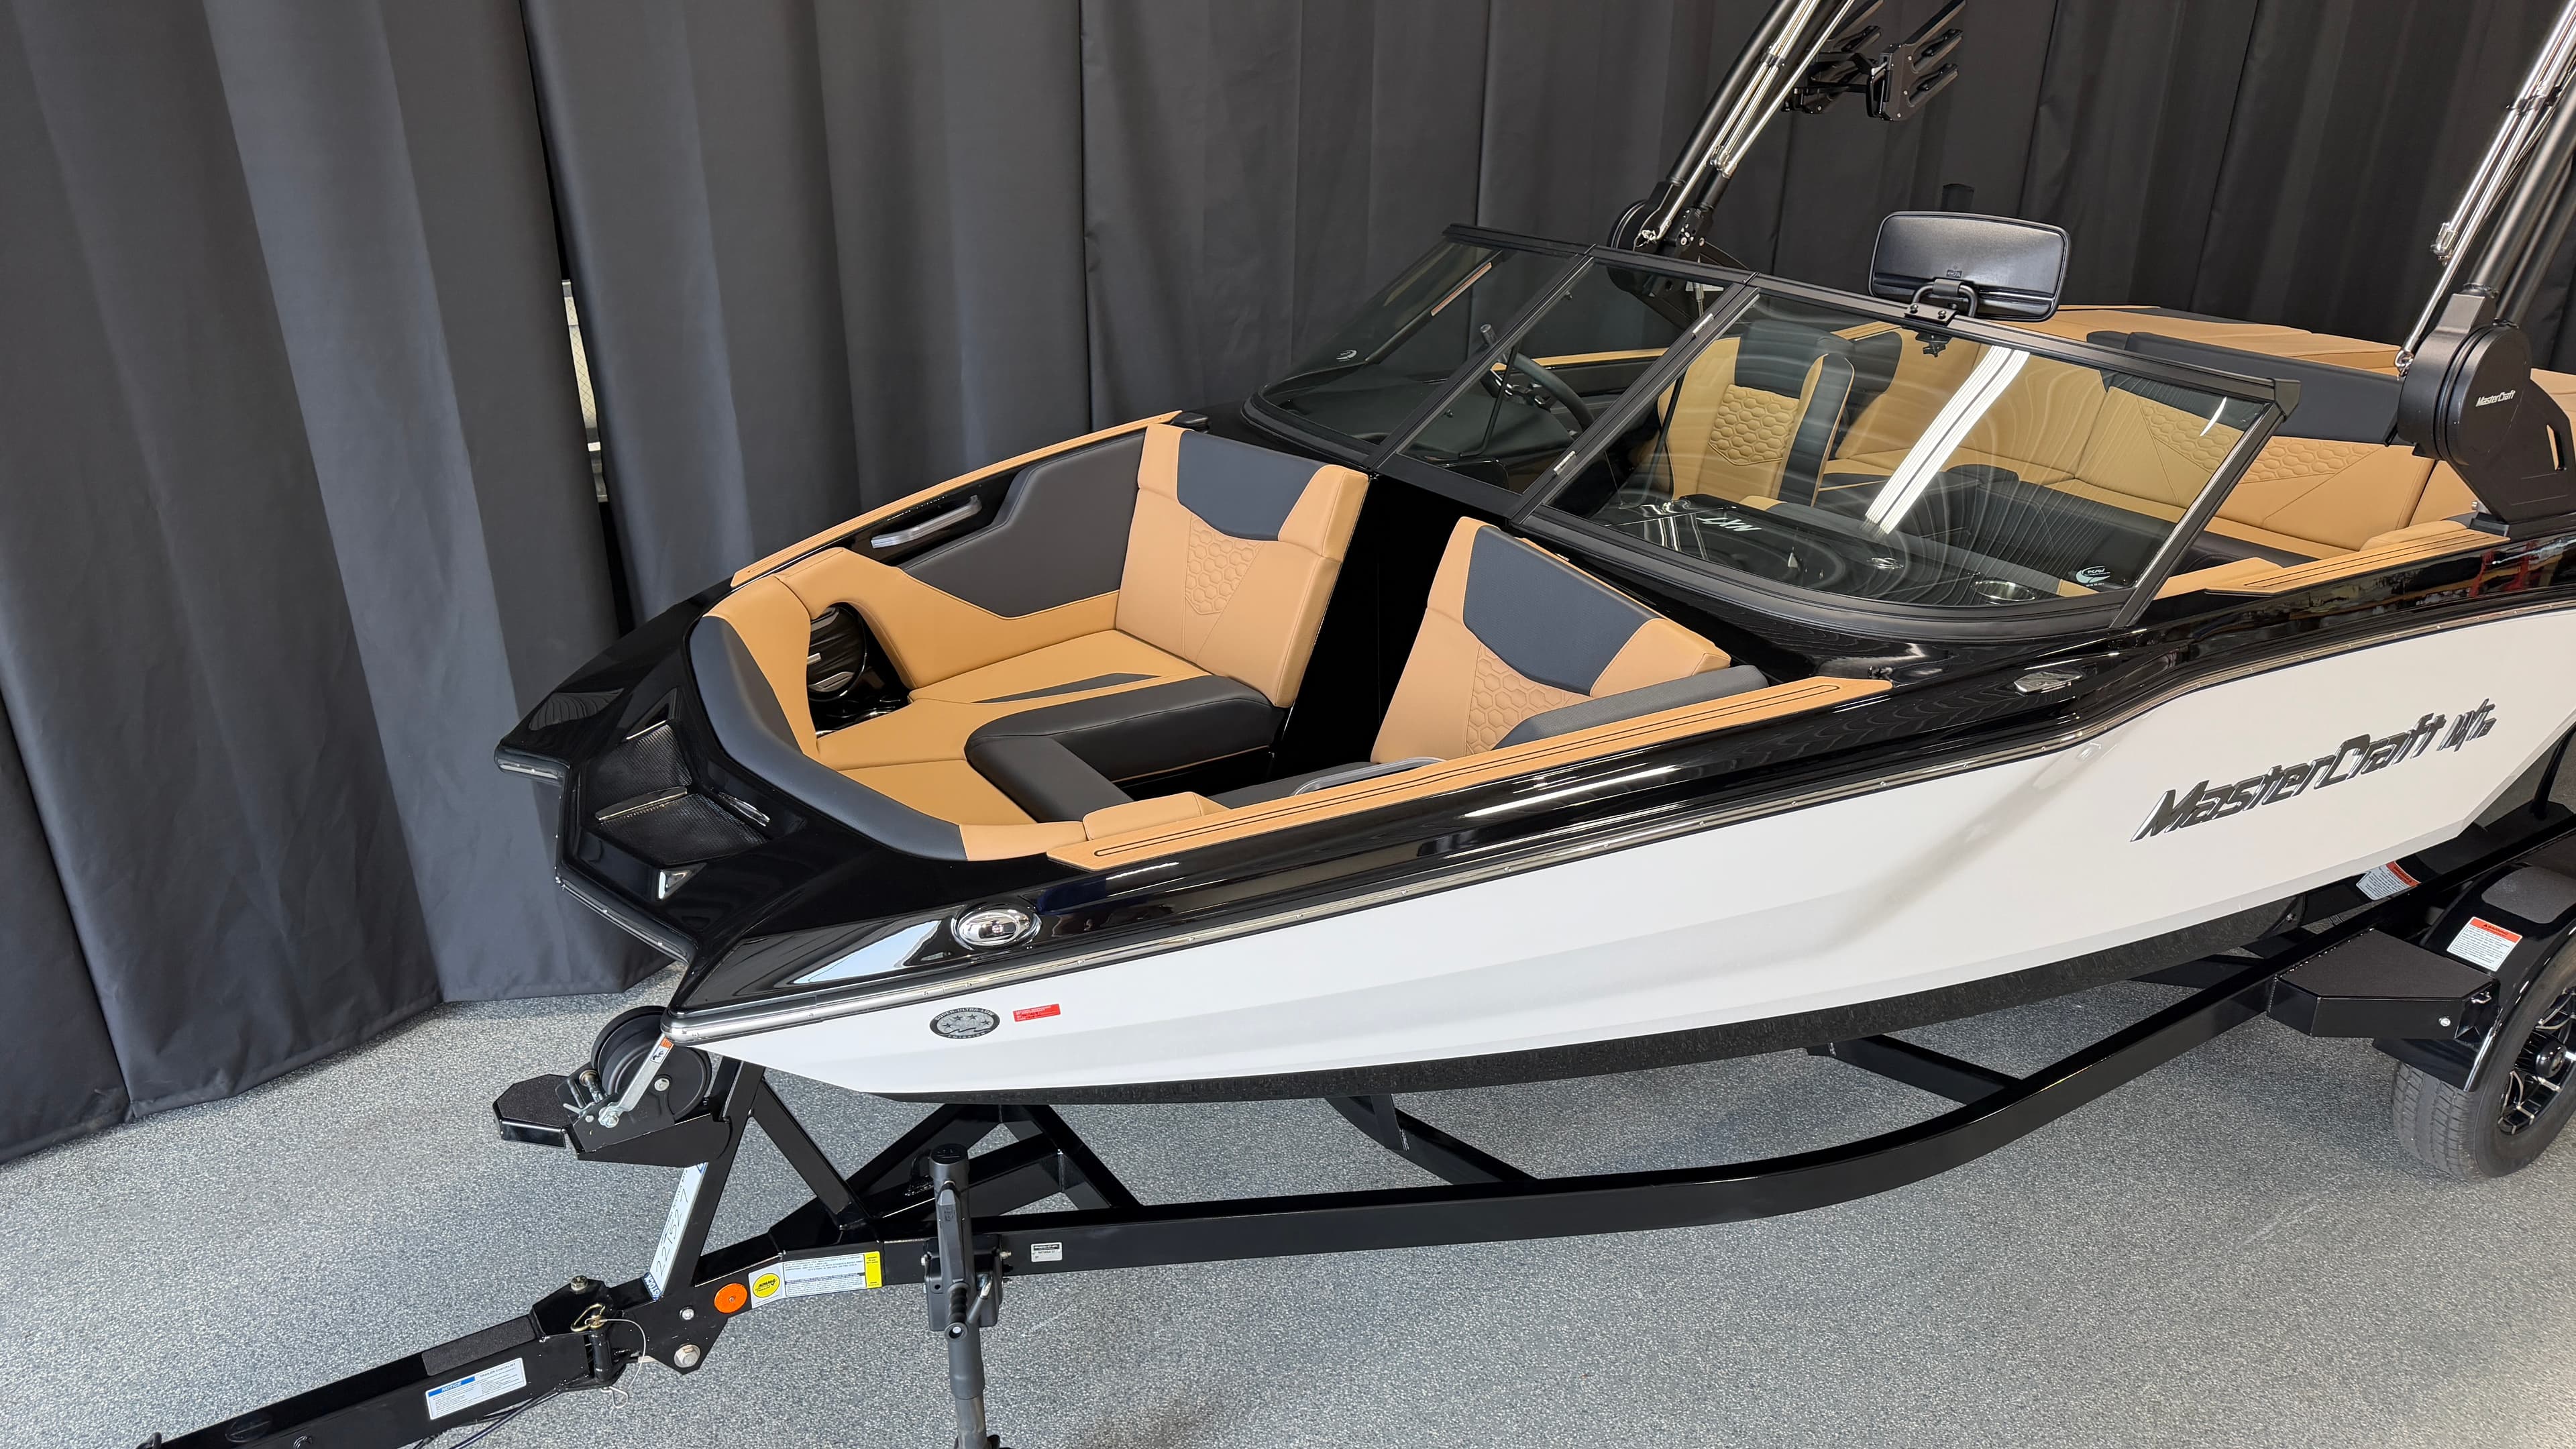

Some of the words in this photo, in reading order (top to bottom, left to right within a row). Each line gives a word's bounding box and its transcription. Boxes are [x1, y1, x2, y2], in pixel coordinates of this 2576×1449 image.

[2475, 390, 2516, 407] MasterCraft
[2130, 712, 2447, 842] MasterCraft
[644, 1273, 661, 1295] STOCK
[441, 1382, 462, 1392] NOTICE
